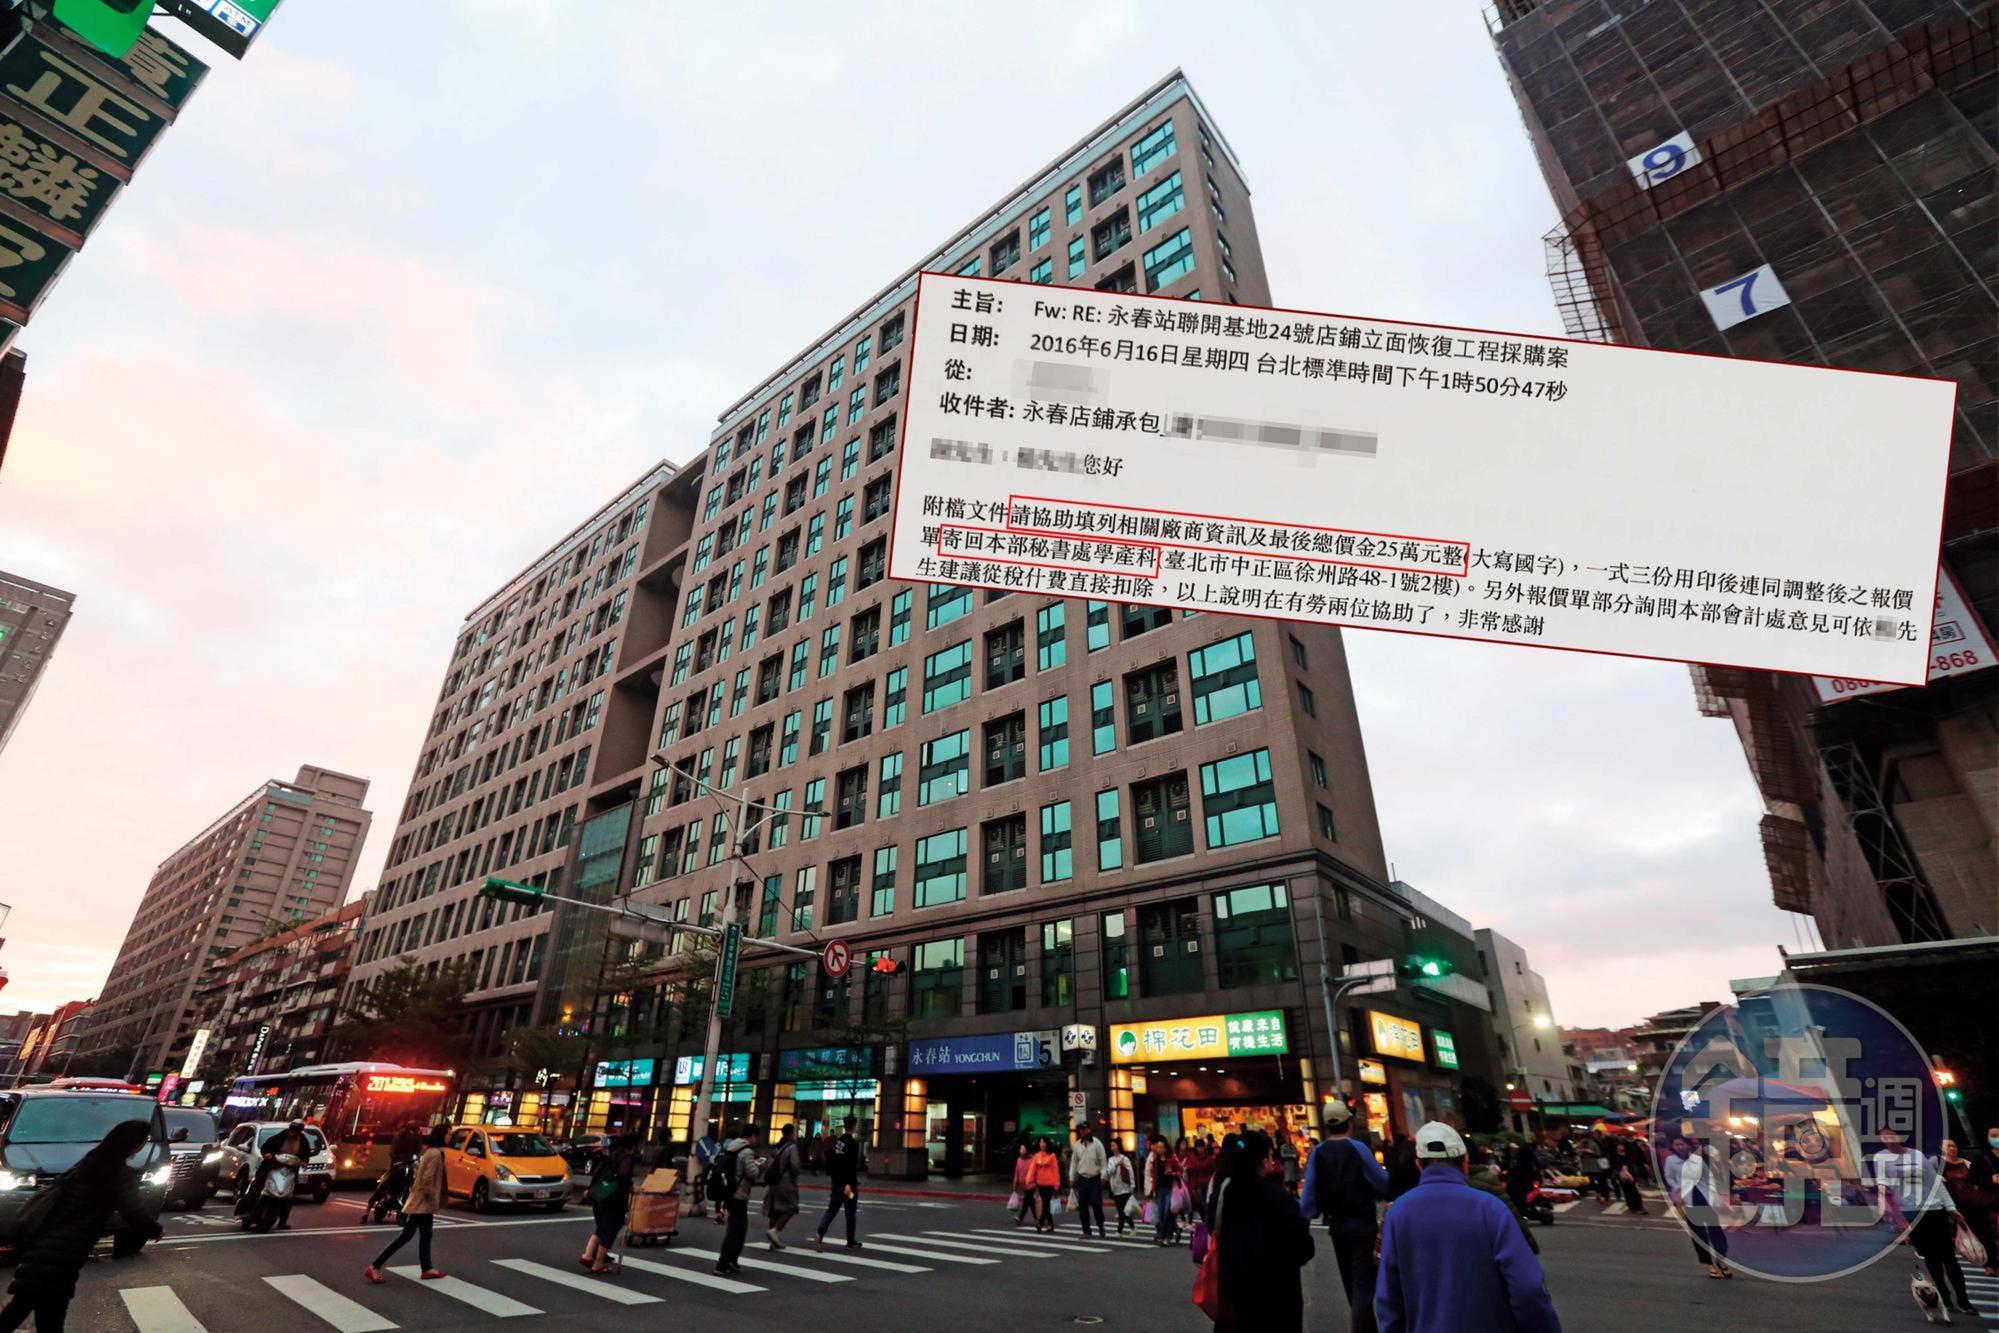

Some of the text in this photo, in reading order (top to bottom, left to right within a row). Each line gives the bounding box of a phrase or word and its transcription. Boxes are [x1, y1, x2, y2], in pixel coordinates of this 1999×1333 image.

[1642, 144, 1687, 180] 9
[1714, 271, 1760, 316] 7
[912, 1039, 1052, 1066] 永春站 YONGCHUN 5
